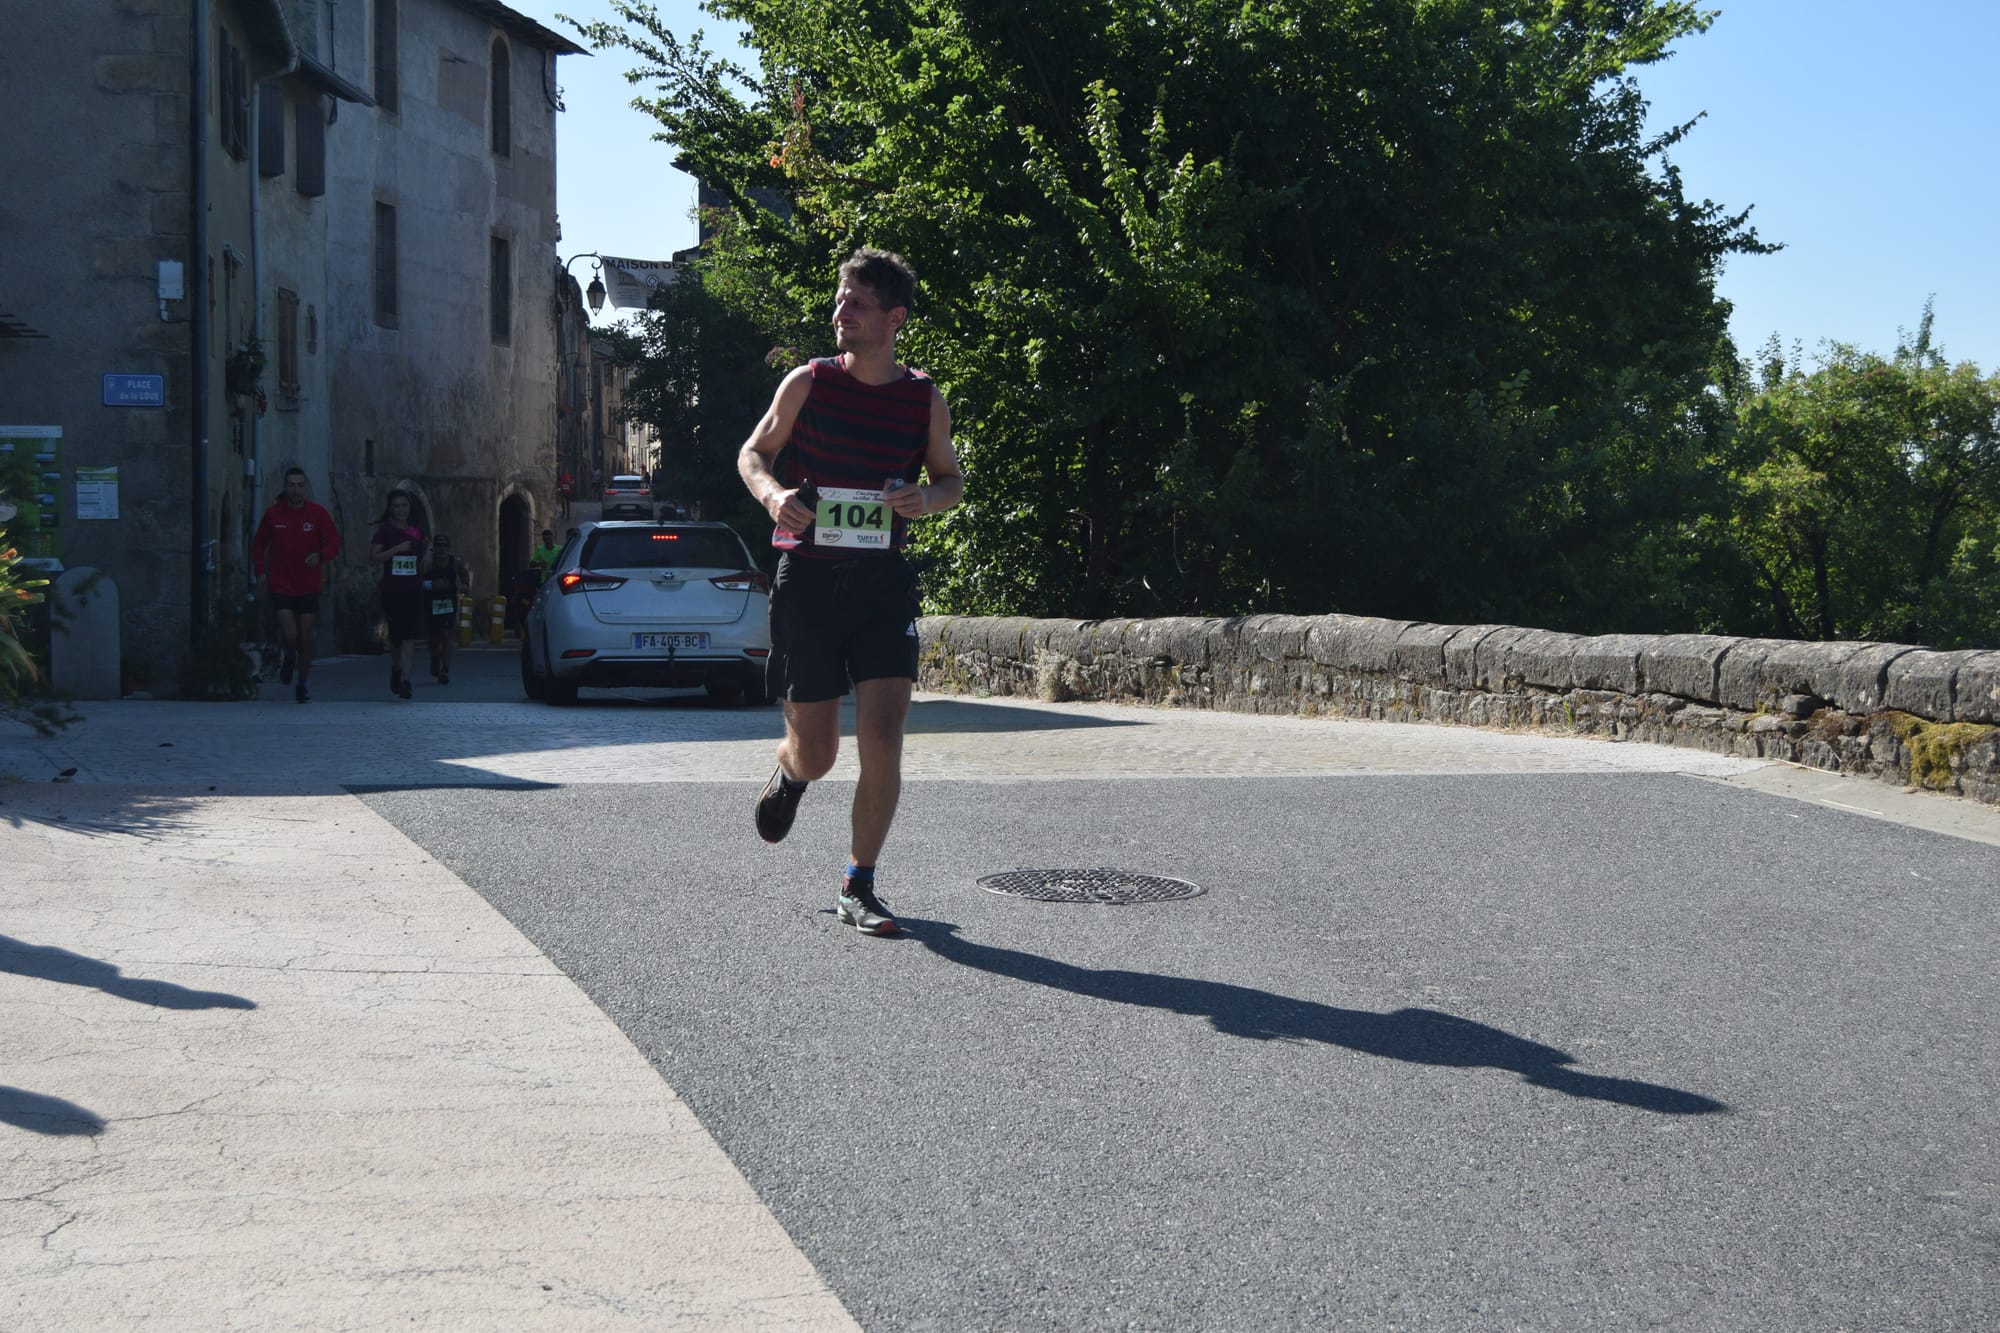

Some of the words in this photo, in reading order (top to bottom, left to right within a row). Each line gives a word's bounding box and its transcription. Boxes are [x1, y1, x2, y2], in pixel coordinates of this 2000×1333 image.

[605, 258, 658, 270] MAISON
[127, 380, 152, 389] PLACE
[828, 503, 883, 529] 104
[397, 560, 414, 569] 141
[642, 635, 698, 648] FA-405-BC
